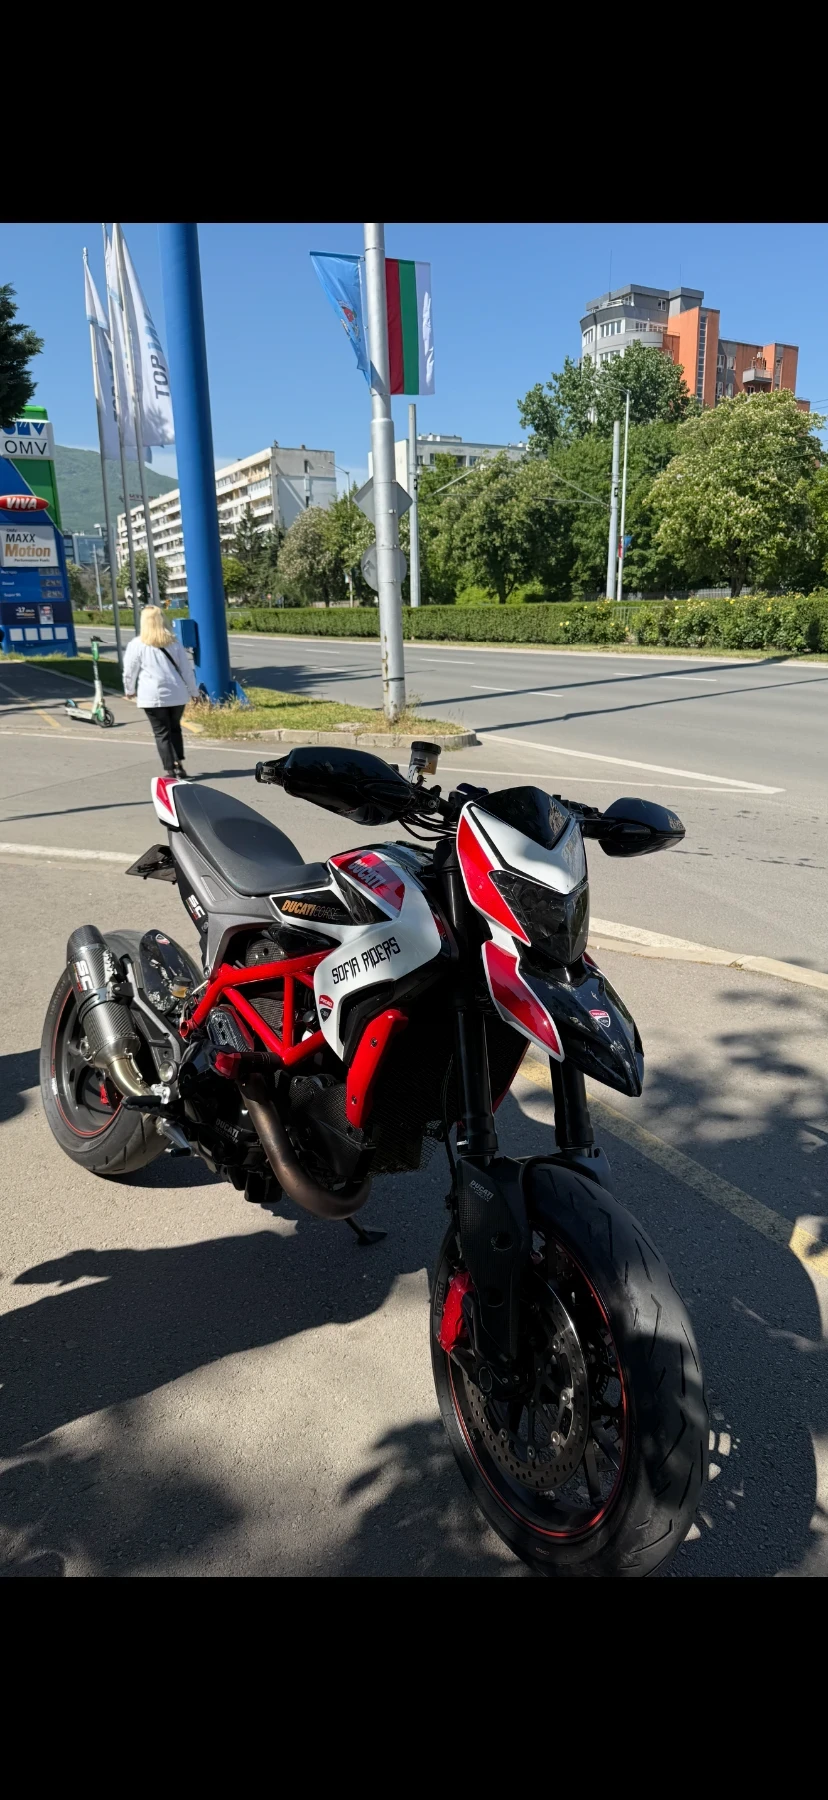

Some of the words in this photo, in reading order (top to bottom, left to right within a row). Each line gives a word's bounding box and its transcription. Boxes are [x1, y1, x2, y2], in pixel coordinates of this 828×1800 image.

[151, 354, 170, 399] TOP
[4, 440, 47, 455] OMV
[6, 497, 37, 509] VIVA
[6, 533, 36, 543] MAXX
[5, 543, 51, 557] Motion
[348, 859, 386, 889] DUCATI
[281, 900, 316, 916] DUCATI
[331, 956, 361, 985] SOFIA
[360, 936, 401, 973] RIDERS
[75, 960, 94, 991] SC
[215, 1117, 240, 1138] DUCATI
[470, 1180, 494, 1200] DUCATI
